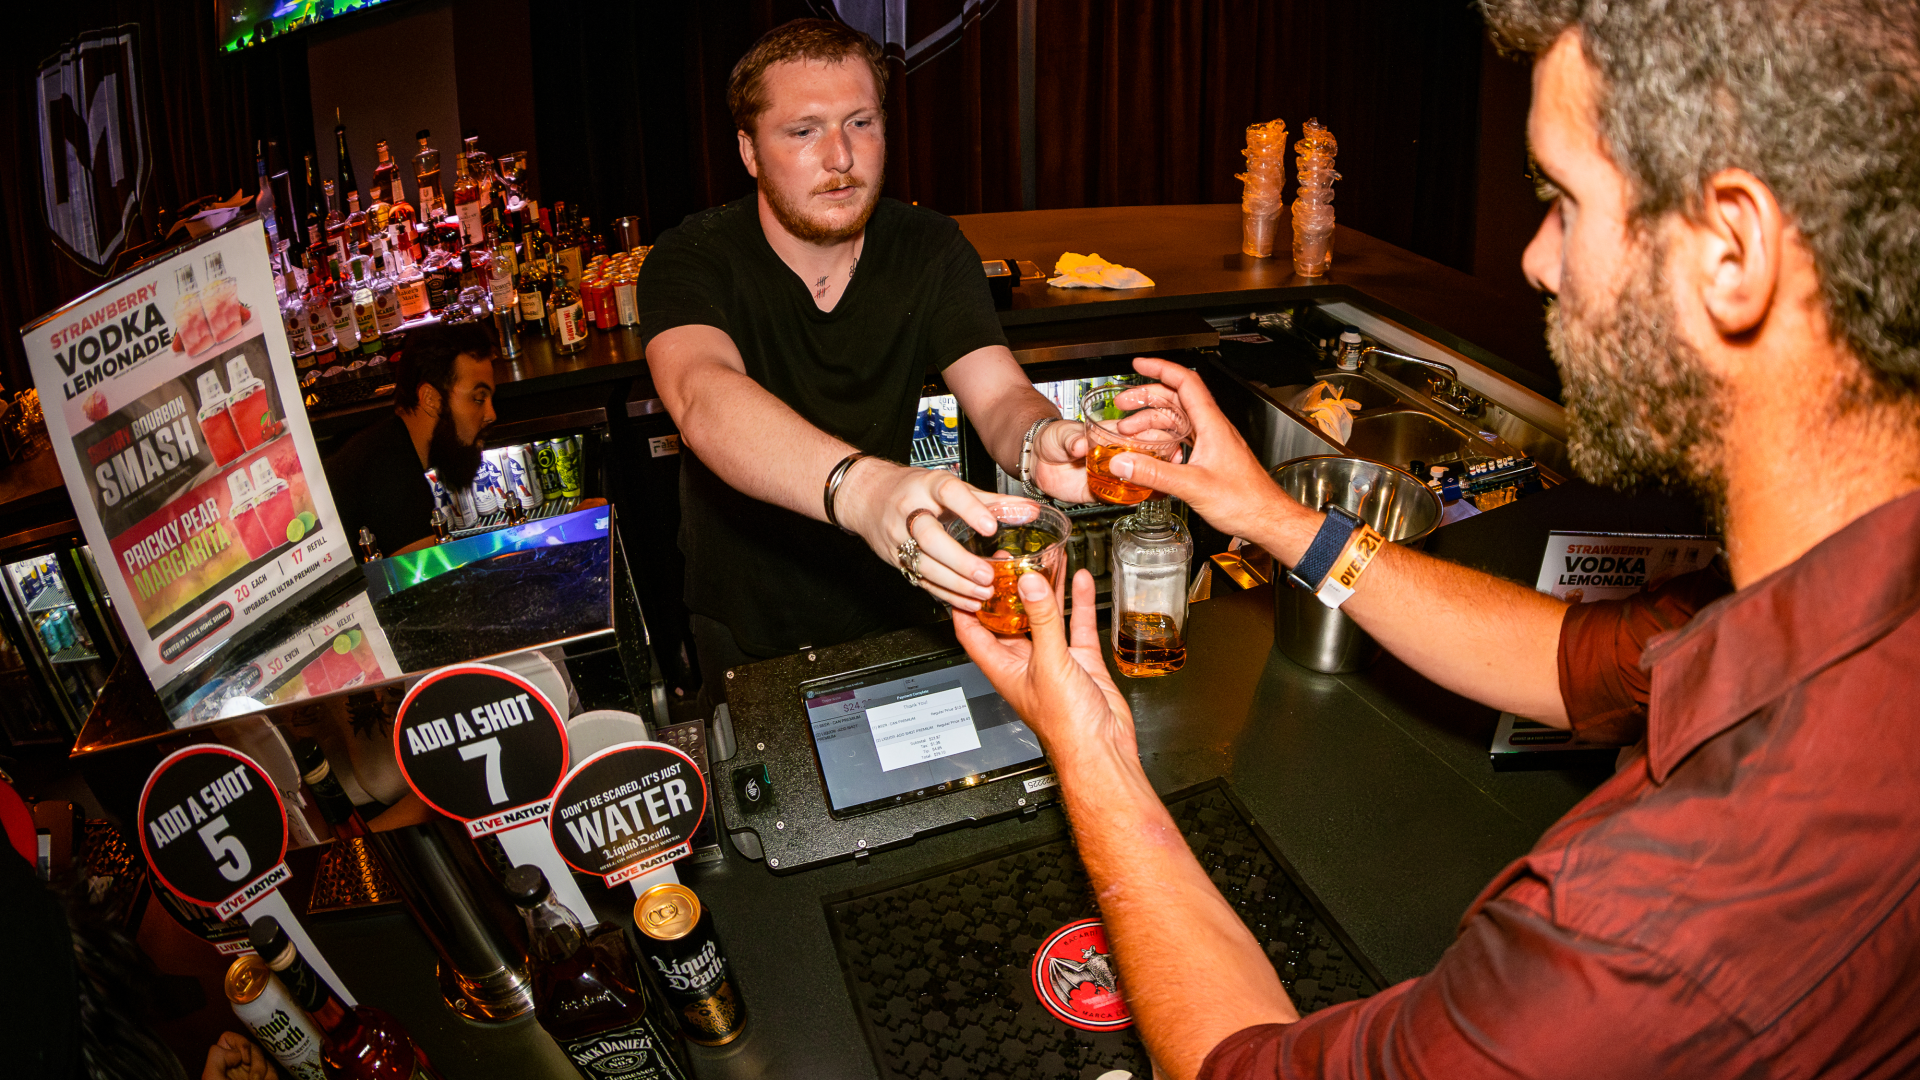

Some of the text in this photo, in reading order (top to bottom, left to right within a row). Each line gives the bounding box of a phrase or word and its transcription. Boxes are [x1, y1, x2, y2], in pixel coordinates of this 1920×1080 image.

[50, 280, 159, 350] STRAWBERRY
[54, 302, 166, 377] VODKA
[63, 327, 172, 400] LEMONADE
[131, 395, 186, 440] BOURBON
[95, 415, 199, 506] SMASH
[122, 497, 221, 575] PRICKLY PEAR
[133, 522, 231, 601] MARGARITA
[1340, 531, 1382, 587] OVER 21
[1566, 544, 1653, 556] STRAWBERRY
[234, 536, 327, 603] 20 EACH 17 REFILL
[243, 552, 333, 616] UPGRADE TO ULTRA PREMIUM +3
[1558, 574, 1645, 587] LEMONADE
[1565, 555, 1645, 574] VODKA
[162, 607, 230, 658] SERVED IN A TAKE HOME SHAKER
[406, 693, 535, 756] ADD A SHOT
[457, 736, 510, 806] 7
[560, 763, 681, 819] DON'T BE SCARED, IT'S JUST
[148, 764, 254, 849] ADD A SHOT
[472, 802, 551, 833] LIVE NATION
[565, 778, 693, 854] WATER
[197, 814, 252, 882] 5
[602, 825, 671, 860] Liquid Death
[610, 846, 686, 883] LIVE NATION
[626, 844, 660, 859] SPARKLING
[659, 834, 681, 846] WATER
[220, 894, 246, 915] LIVE
[245, 867, 286, 900] NATION
[219, 943, 240, 951] LIVE
[651, 940, 716, 978] Liquid
[665, 957, 723, 990] Death
[250, 1009, 290, 1041] iquid
[1082, 1010, 1113, 1019] MARCA
[572, 1035, 653, 1066] JACK DANIEL'S
